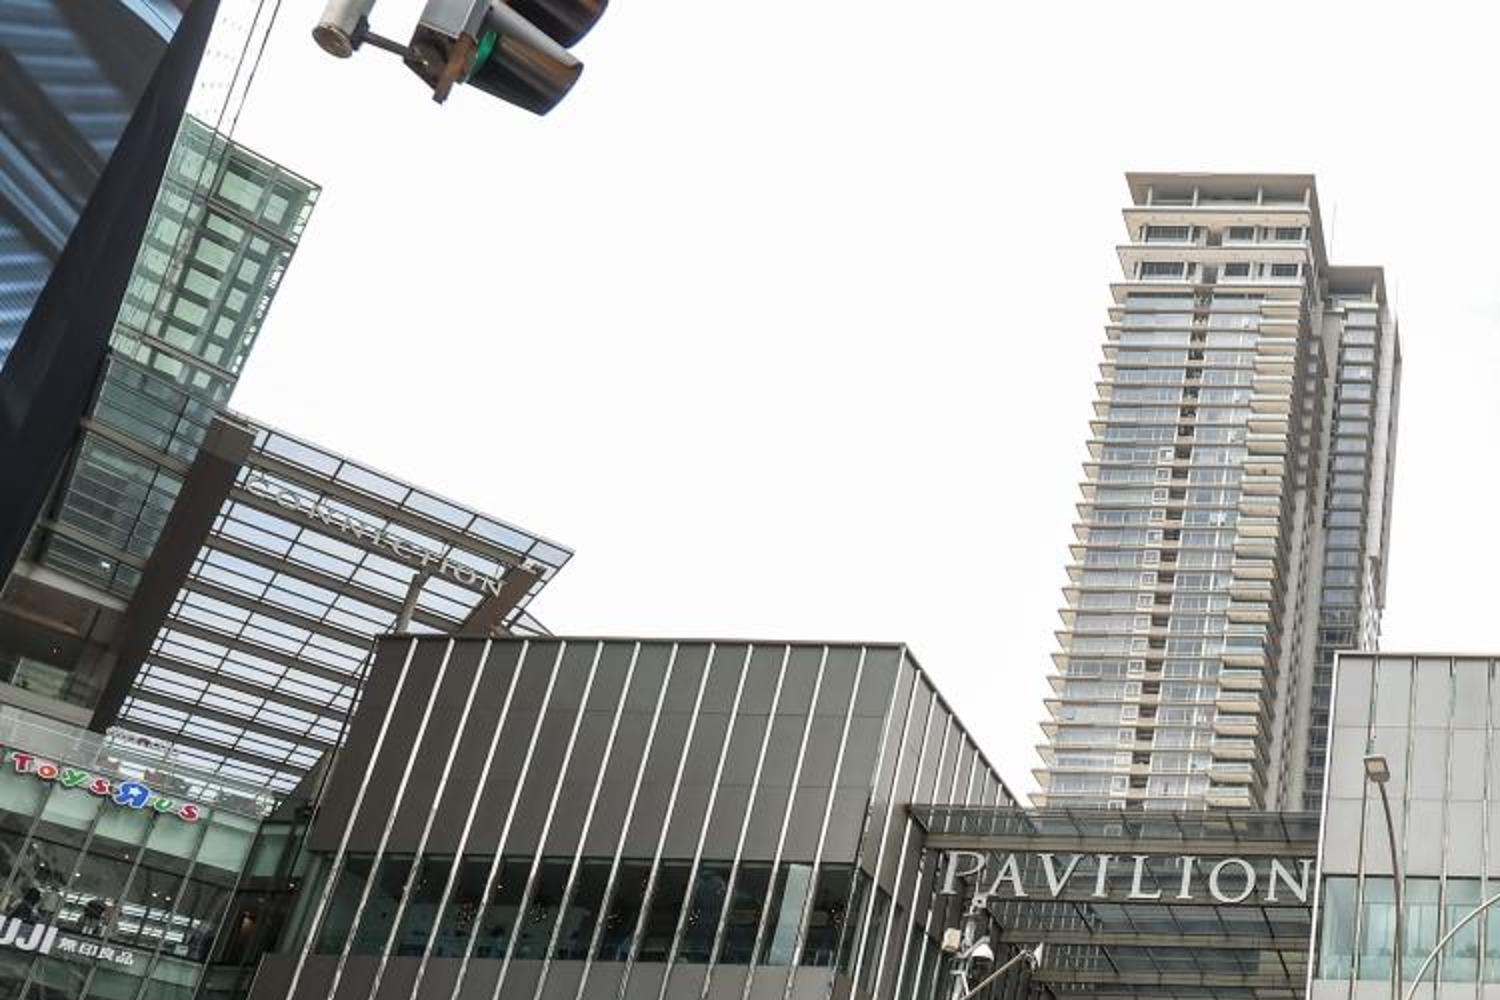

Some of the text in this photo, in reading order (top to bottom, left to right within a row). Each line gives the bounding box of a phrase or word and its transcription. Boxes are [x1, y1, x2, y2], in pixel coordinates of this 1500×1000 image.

[939, 850, 1315, 903] PAVILION
[57, 935, 135, 967] 無印良品
